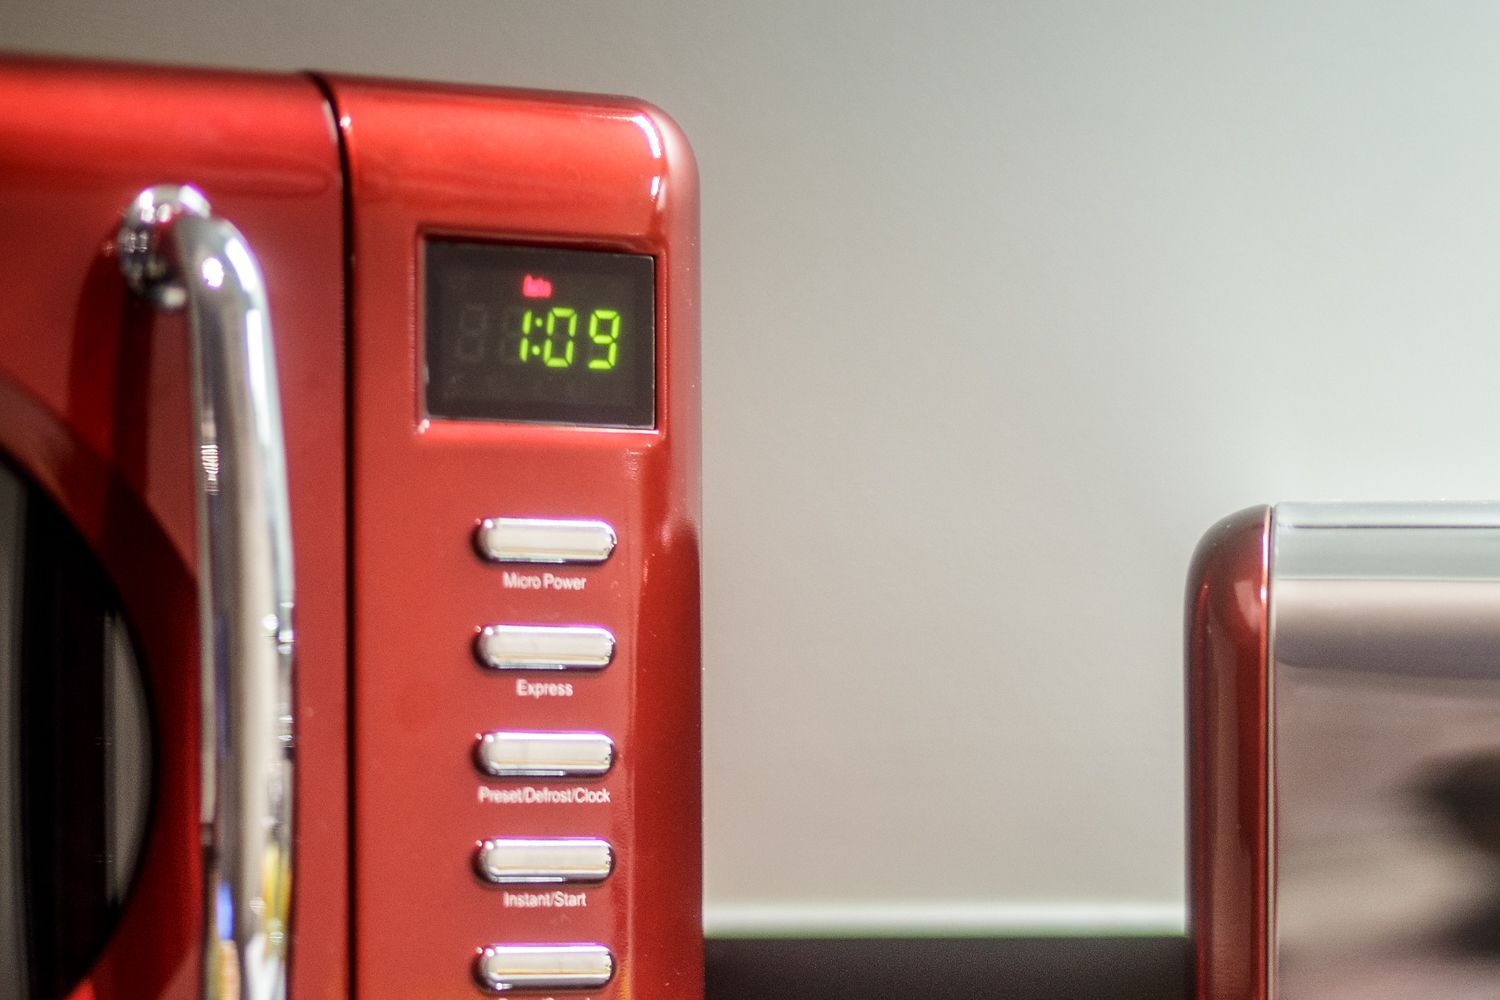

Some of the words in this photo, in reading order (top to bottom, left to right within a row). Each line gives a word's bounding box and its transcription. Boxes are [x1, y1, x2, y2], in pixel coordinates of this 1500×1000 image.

[519, 307, 621, 370] 1:09
[502, 571, 541, 590] Micro
[543, 573, 587, 590] Power
[515, 678, 574, 699] Express
[478, 786, 611, 804] Preset/Defrost/Clock
[503, 891, 587, 908] Instant/Start
